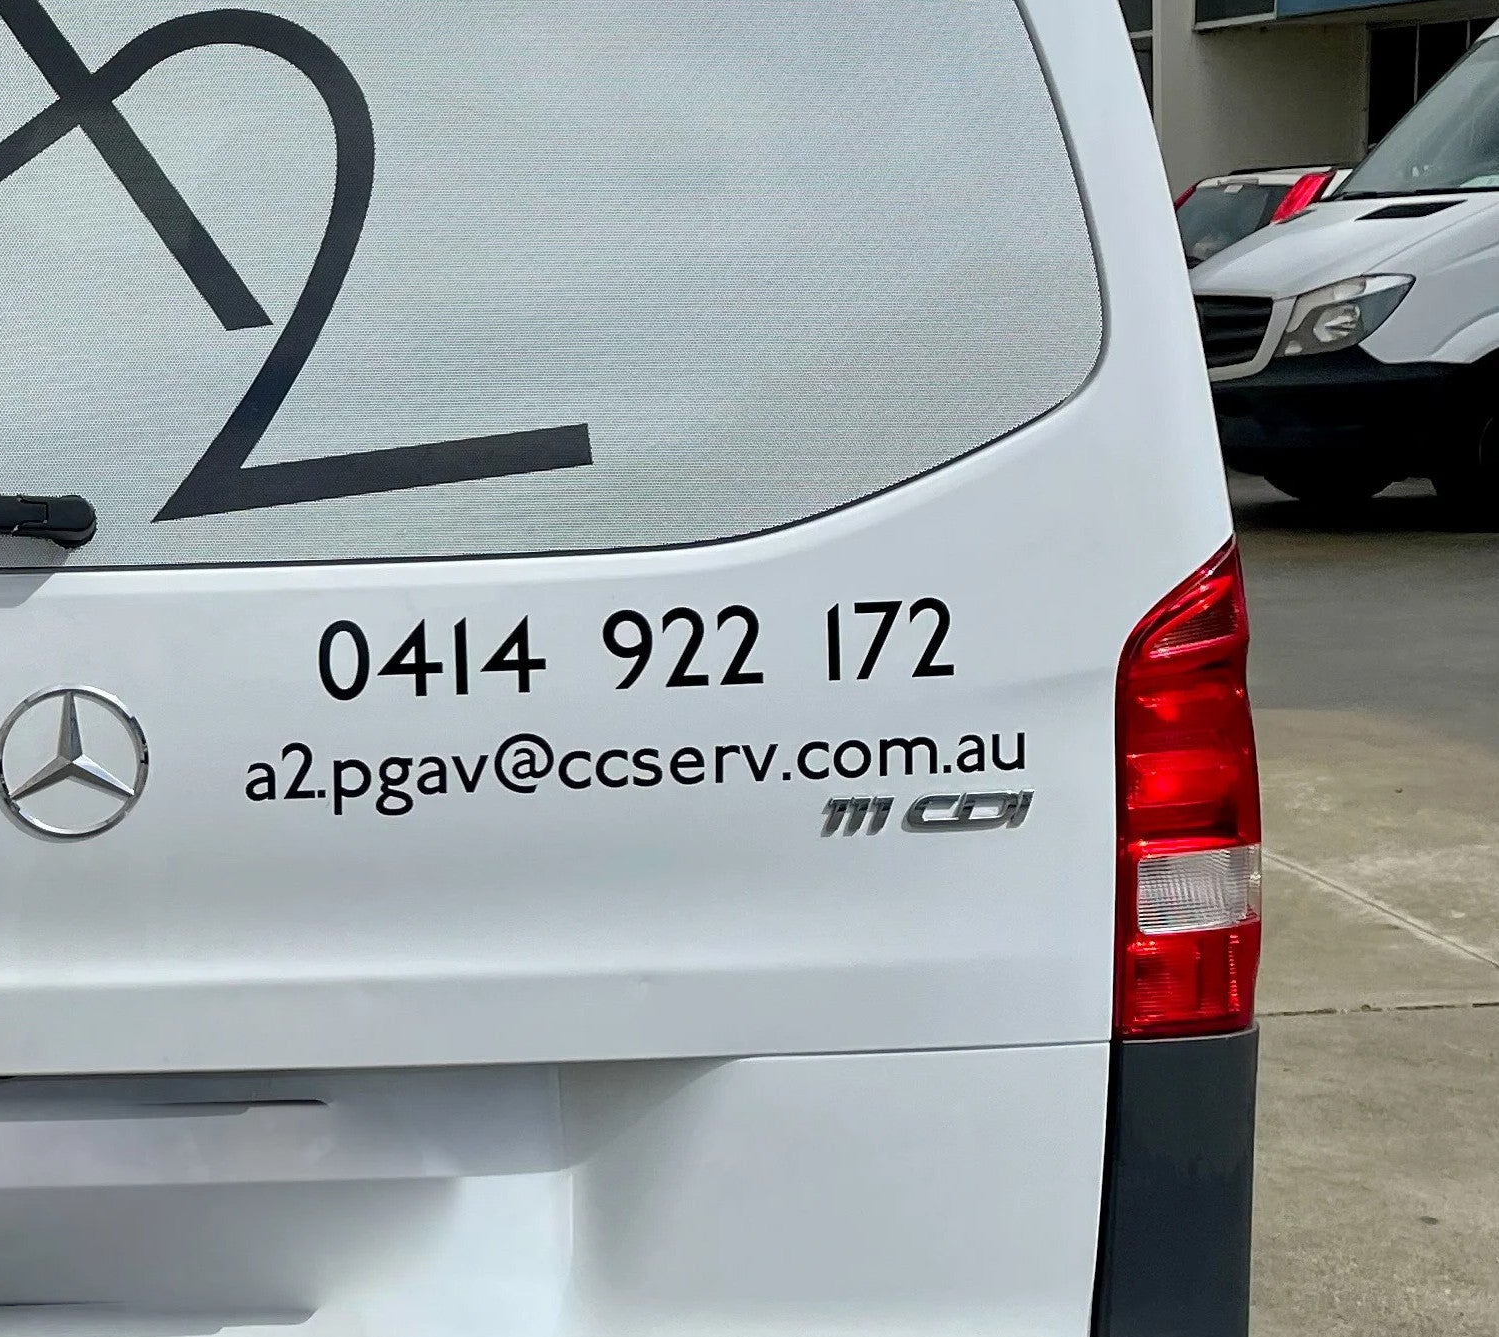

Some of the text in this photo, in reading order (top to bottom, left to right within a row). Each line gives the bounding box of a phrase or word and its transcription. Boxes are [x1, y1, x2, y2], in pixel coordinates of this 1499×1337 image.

[318, 596, 956, 701] 0414 922 172
[244, 731, 1028, 816] a2.pgav@ccserv.com.au
[901, 789, 1035, 833] CDI
